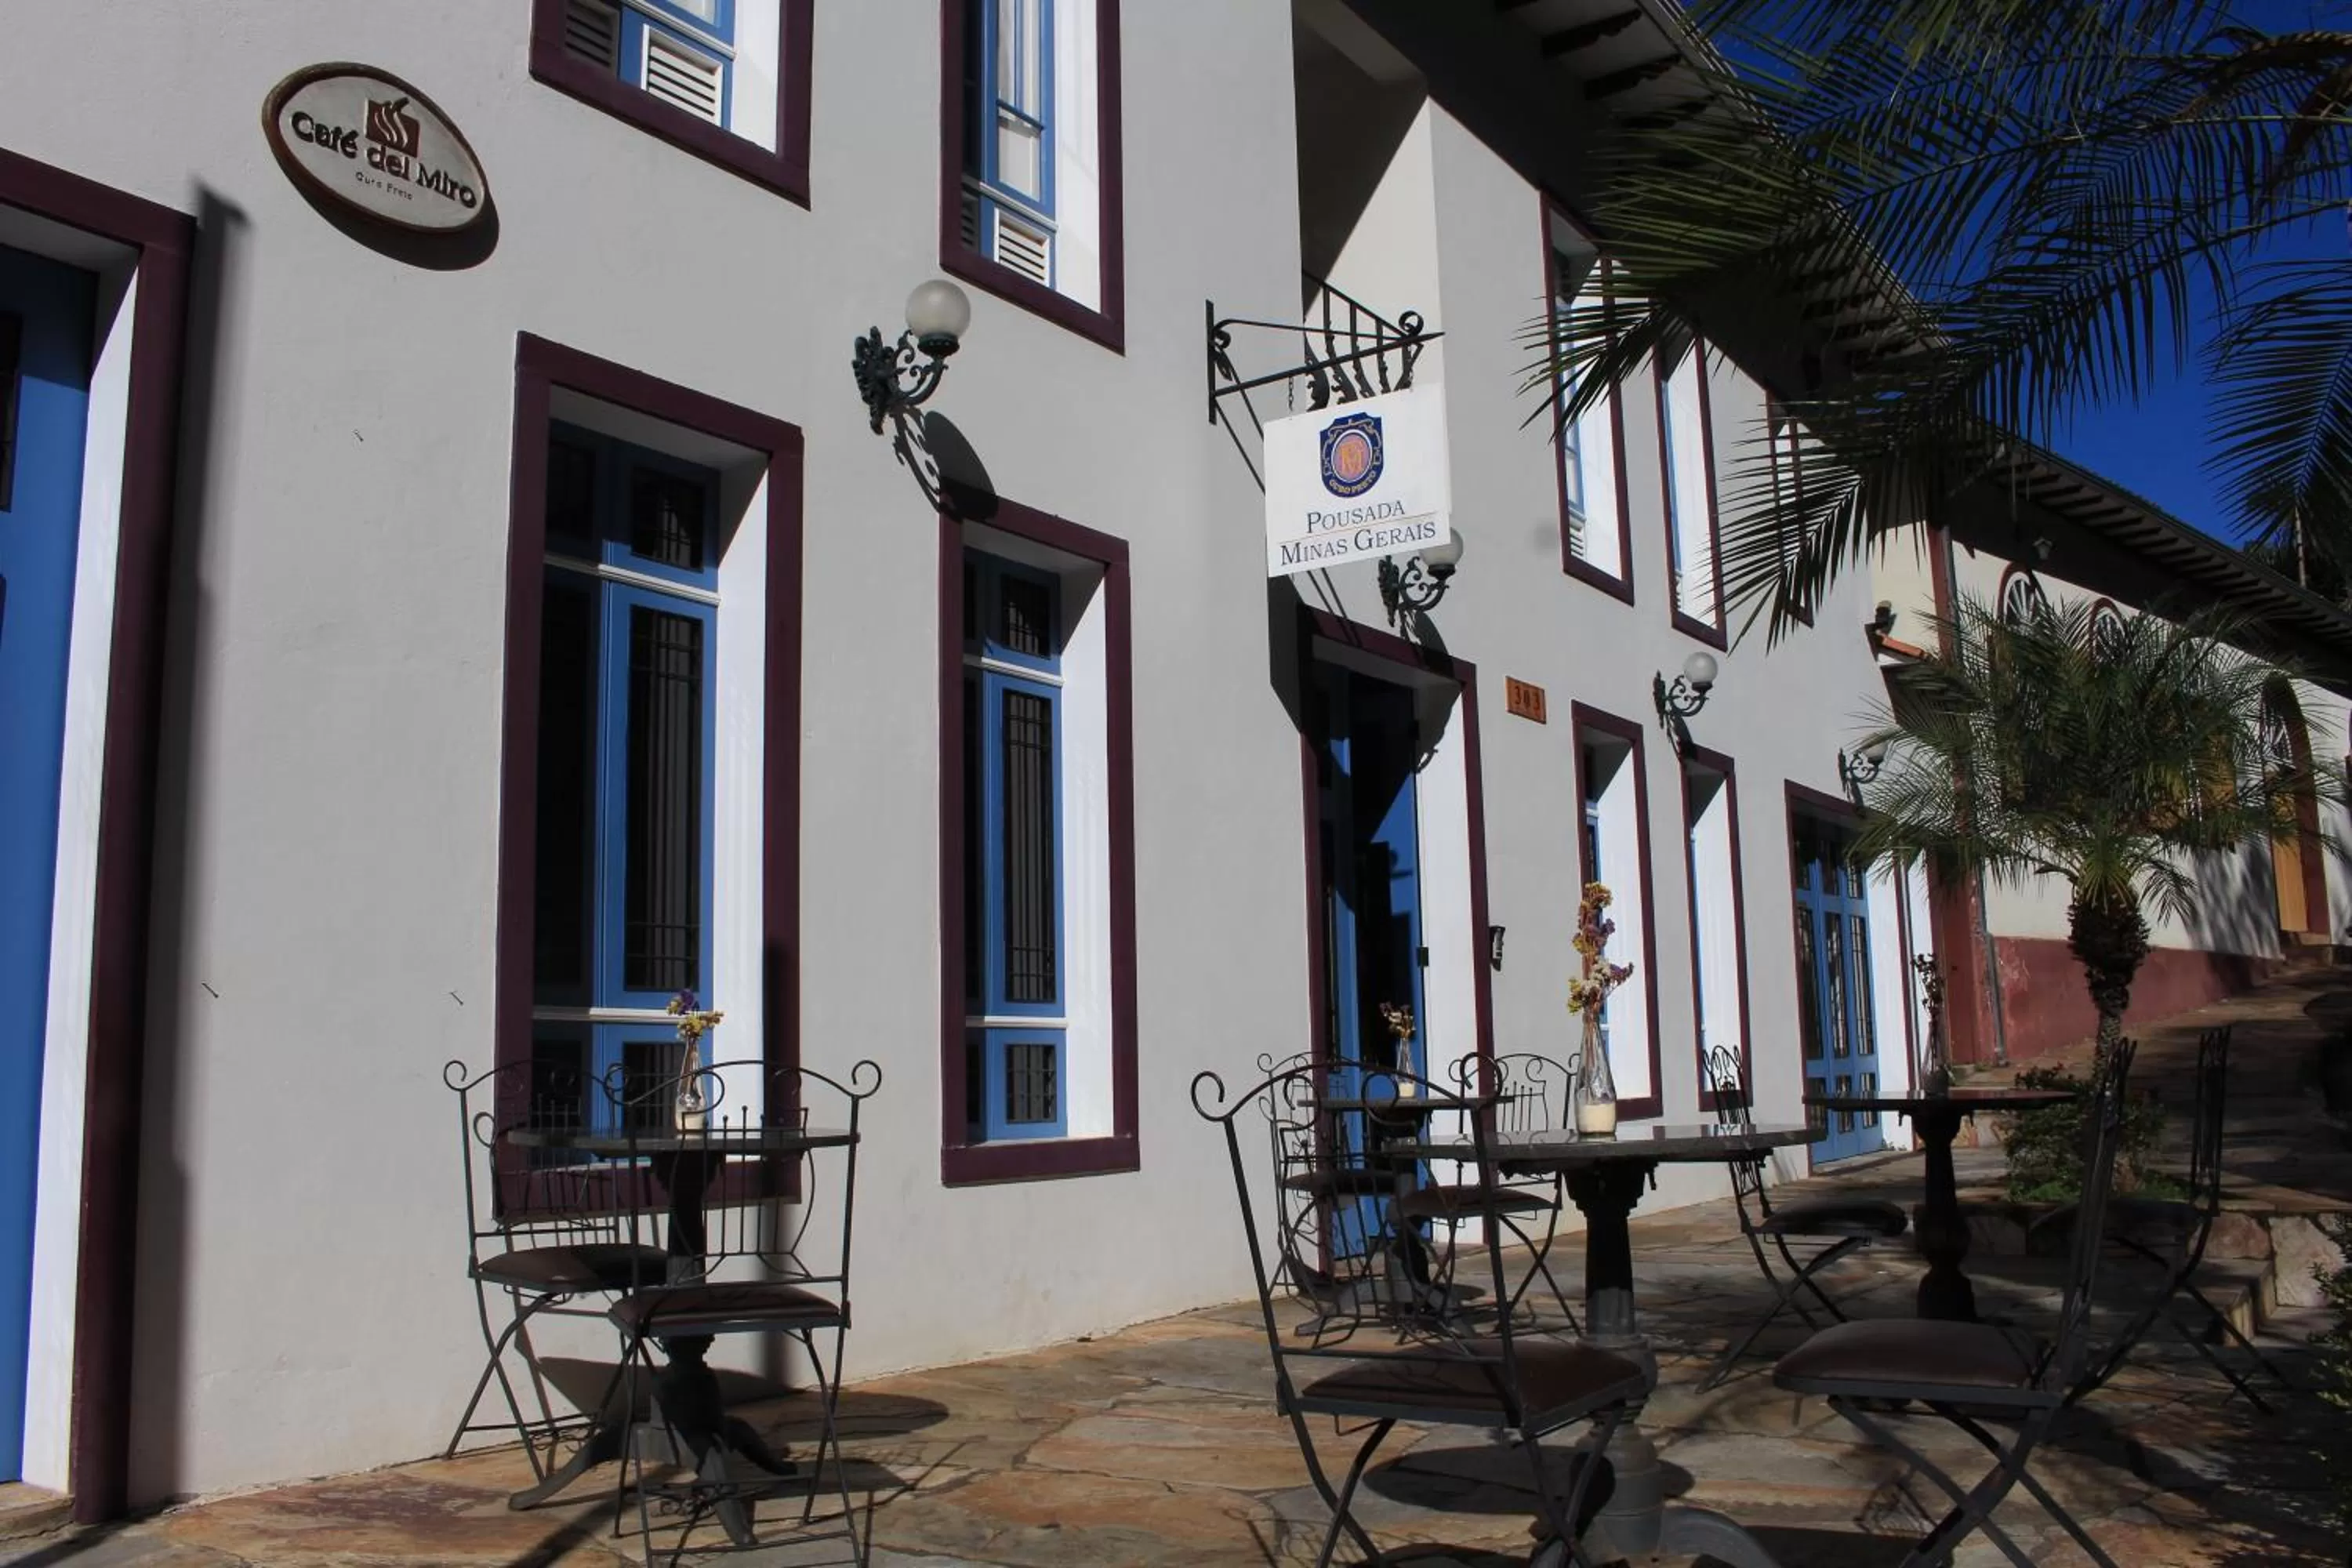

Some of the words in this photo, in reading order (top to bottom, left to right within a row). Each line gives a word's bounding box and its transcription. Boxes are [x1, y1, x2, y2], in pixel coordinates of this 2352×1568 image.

[291, 111, 359, 159] Café
[365, 144, 411, 181] del
[416, 162, 477, 209] Miro
[1305, 499, 1406, 535] POUSADA
[1280, 539, 1348, 566] MINAS
[1353, 521, 1436, 551] GERAIS
